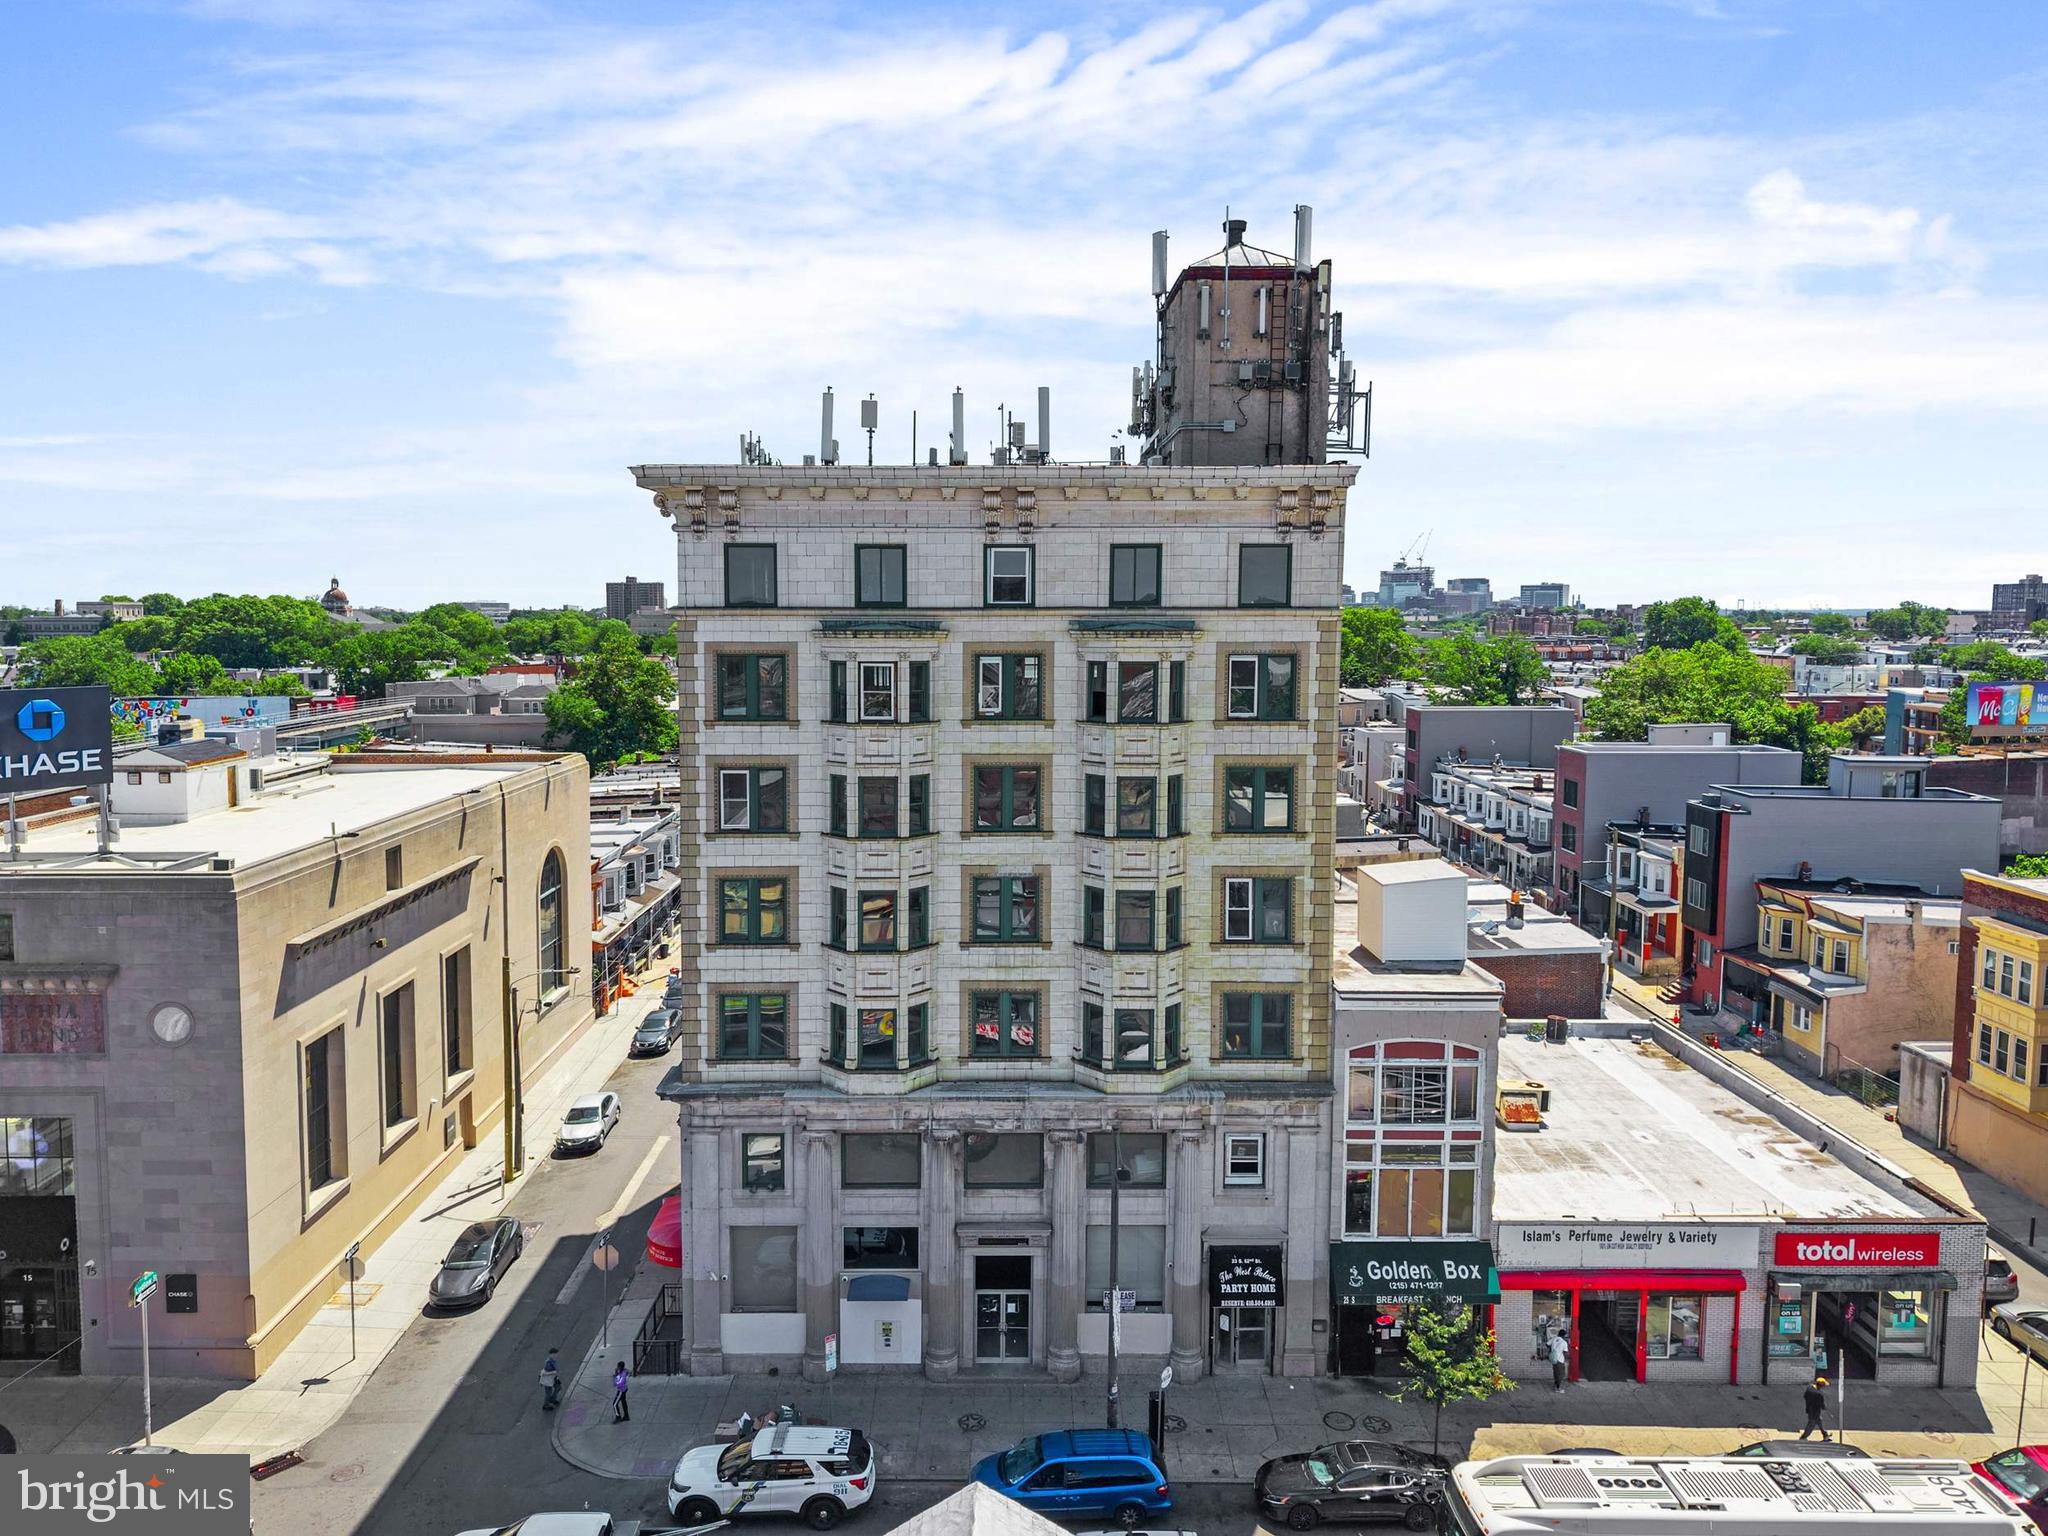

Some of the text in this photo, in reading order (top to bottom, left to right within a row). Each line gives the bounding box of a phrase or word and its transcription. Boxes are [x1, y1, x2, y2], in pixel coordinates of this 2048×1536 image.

[0, 749, 103, 779] HASE
[1522, 1229, 1718, 1245] Islam's Perfume Jewelry & Variety
[1797, 1239, 1924, 1261] total wireless
[1218, 1266, 1277, 1283] The West Palace
[1367, 1260, 1482, 1280] Golden Box
[1221, 1284, 1276, 1293] PARTY HOME
[1389, 1281, 1408, 1289] (215)
[1376, 1295, 1424, 1304] BREAKFAST
